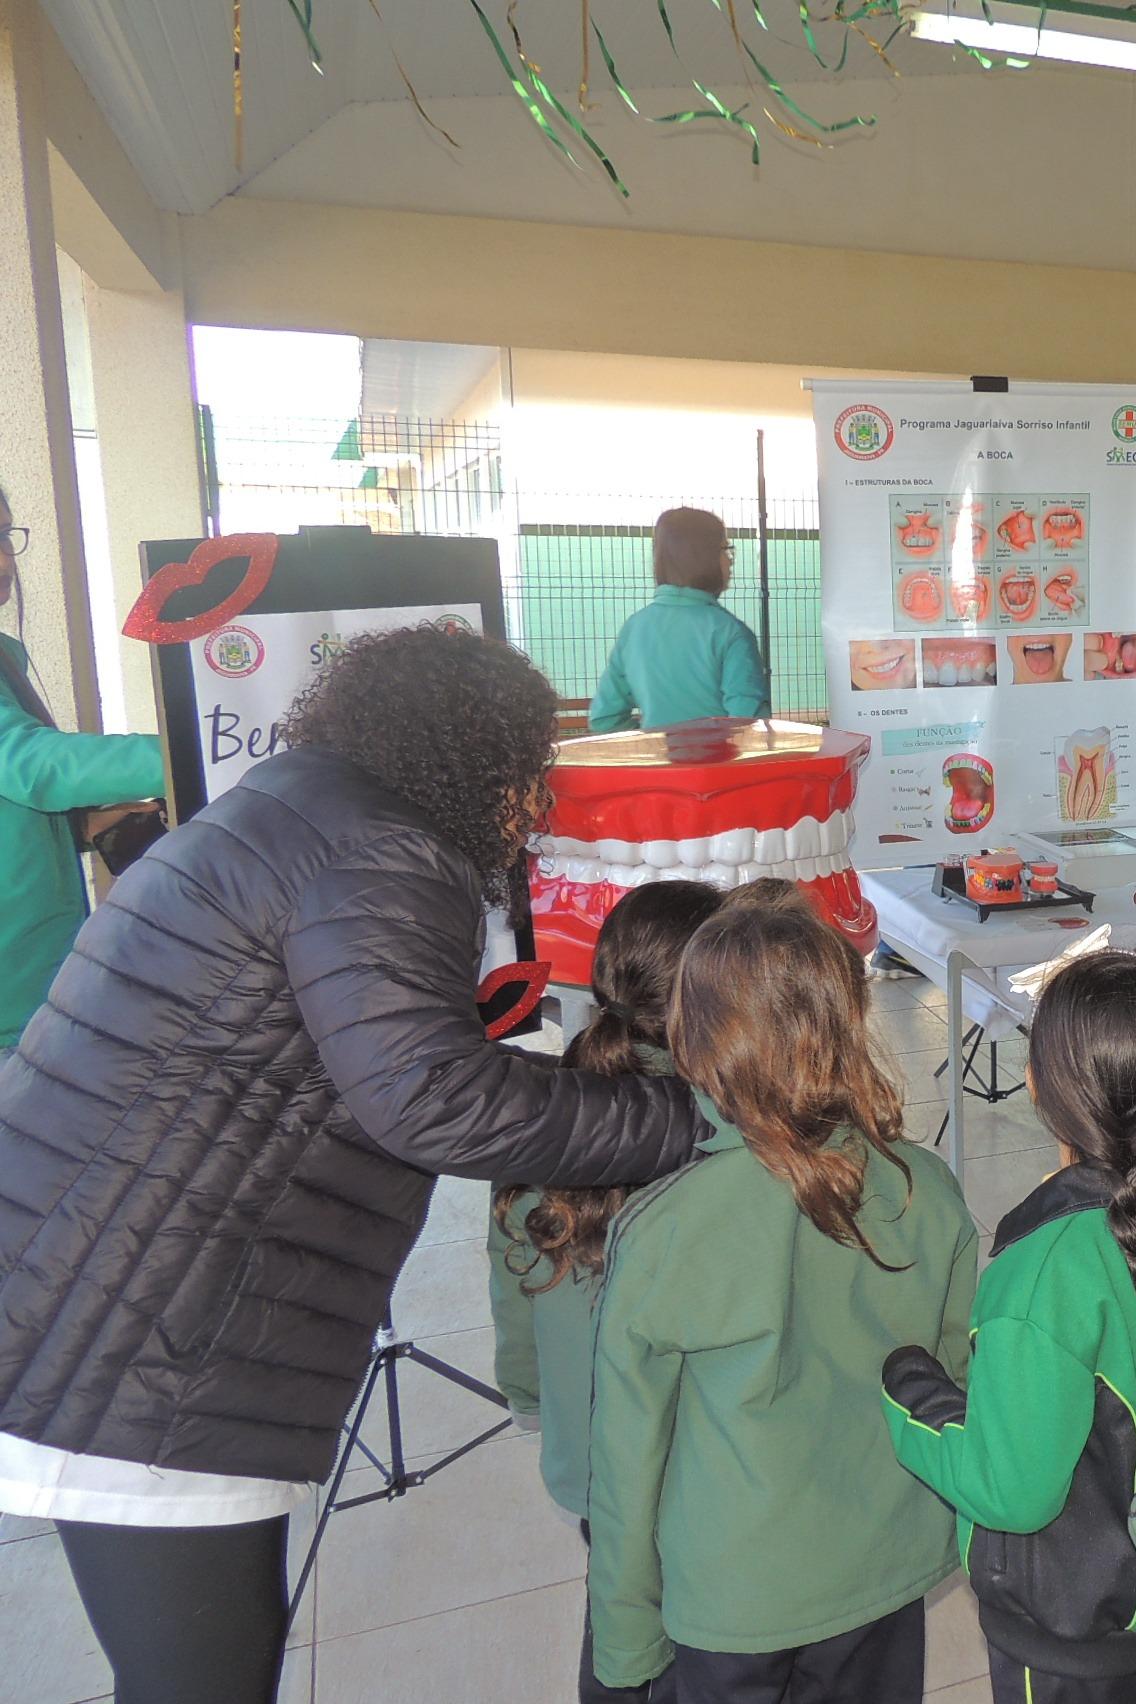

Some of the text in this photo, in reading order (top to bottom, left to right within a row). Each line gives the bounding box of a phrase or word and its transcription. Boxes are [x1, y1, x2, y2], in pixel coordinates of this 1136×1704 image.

[900, 419, 951, 431] Programa
[1017, 419, 1053, 430] Sorriso
[1056, 420, 1090, 430] Infantil
[977, 450, 1013, 460] A BOCA
[855, 479, 901, 487] ESTRUTURAS
[916, 727, 962, 737] FUNÇÃO
